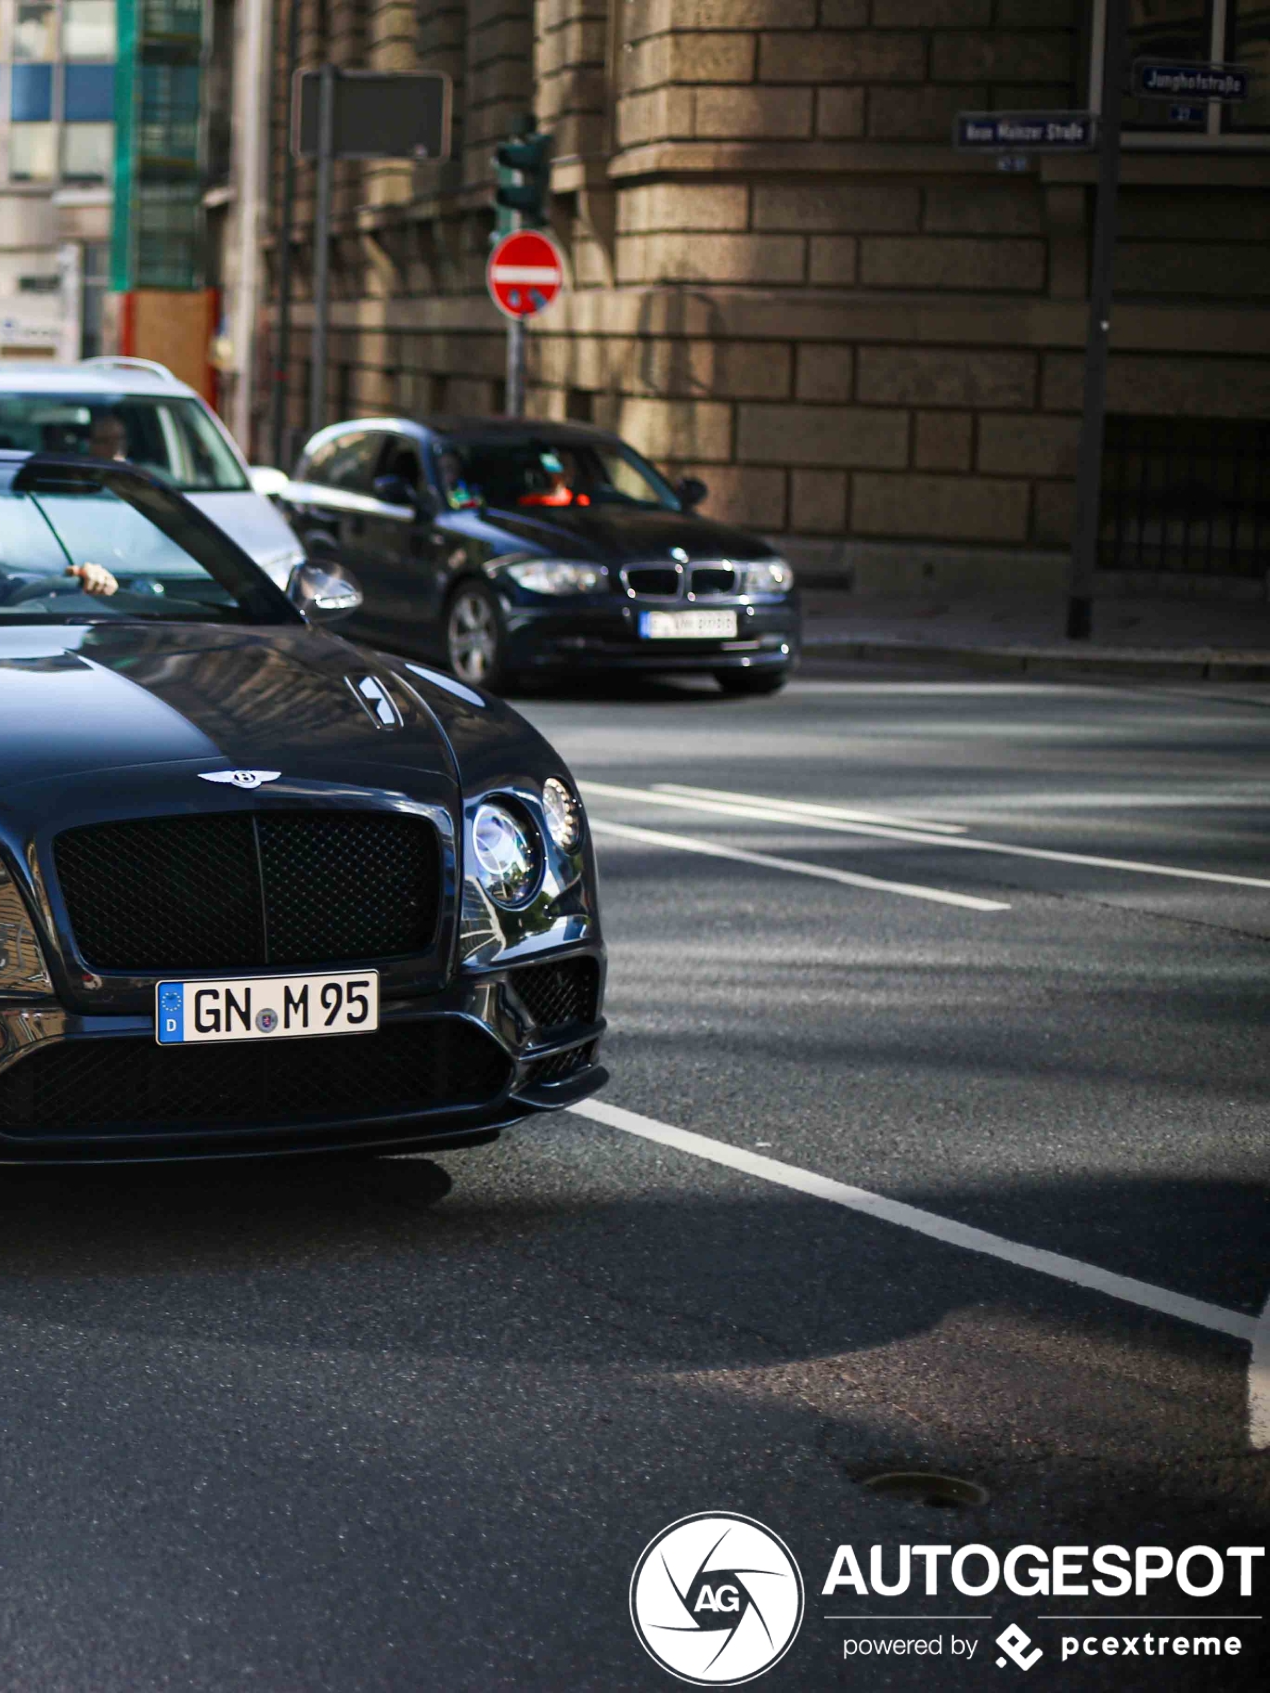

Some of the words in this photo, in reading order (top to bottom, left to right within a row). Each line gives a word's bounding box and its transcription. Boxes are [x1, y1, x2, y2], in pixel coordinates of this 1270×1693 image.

[1147, 69, 1242, 94] Junghofstraße
[194, 986, 252, 1034] GN
[283, 983, 309, 1030] M
[320, 980, 370, 1027] 95
[165, 1018, 177, 1033] D
